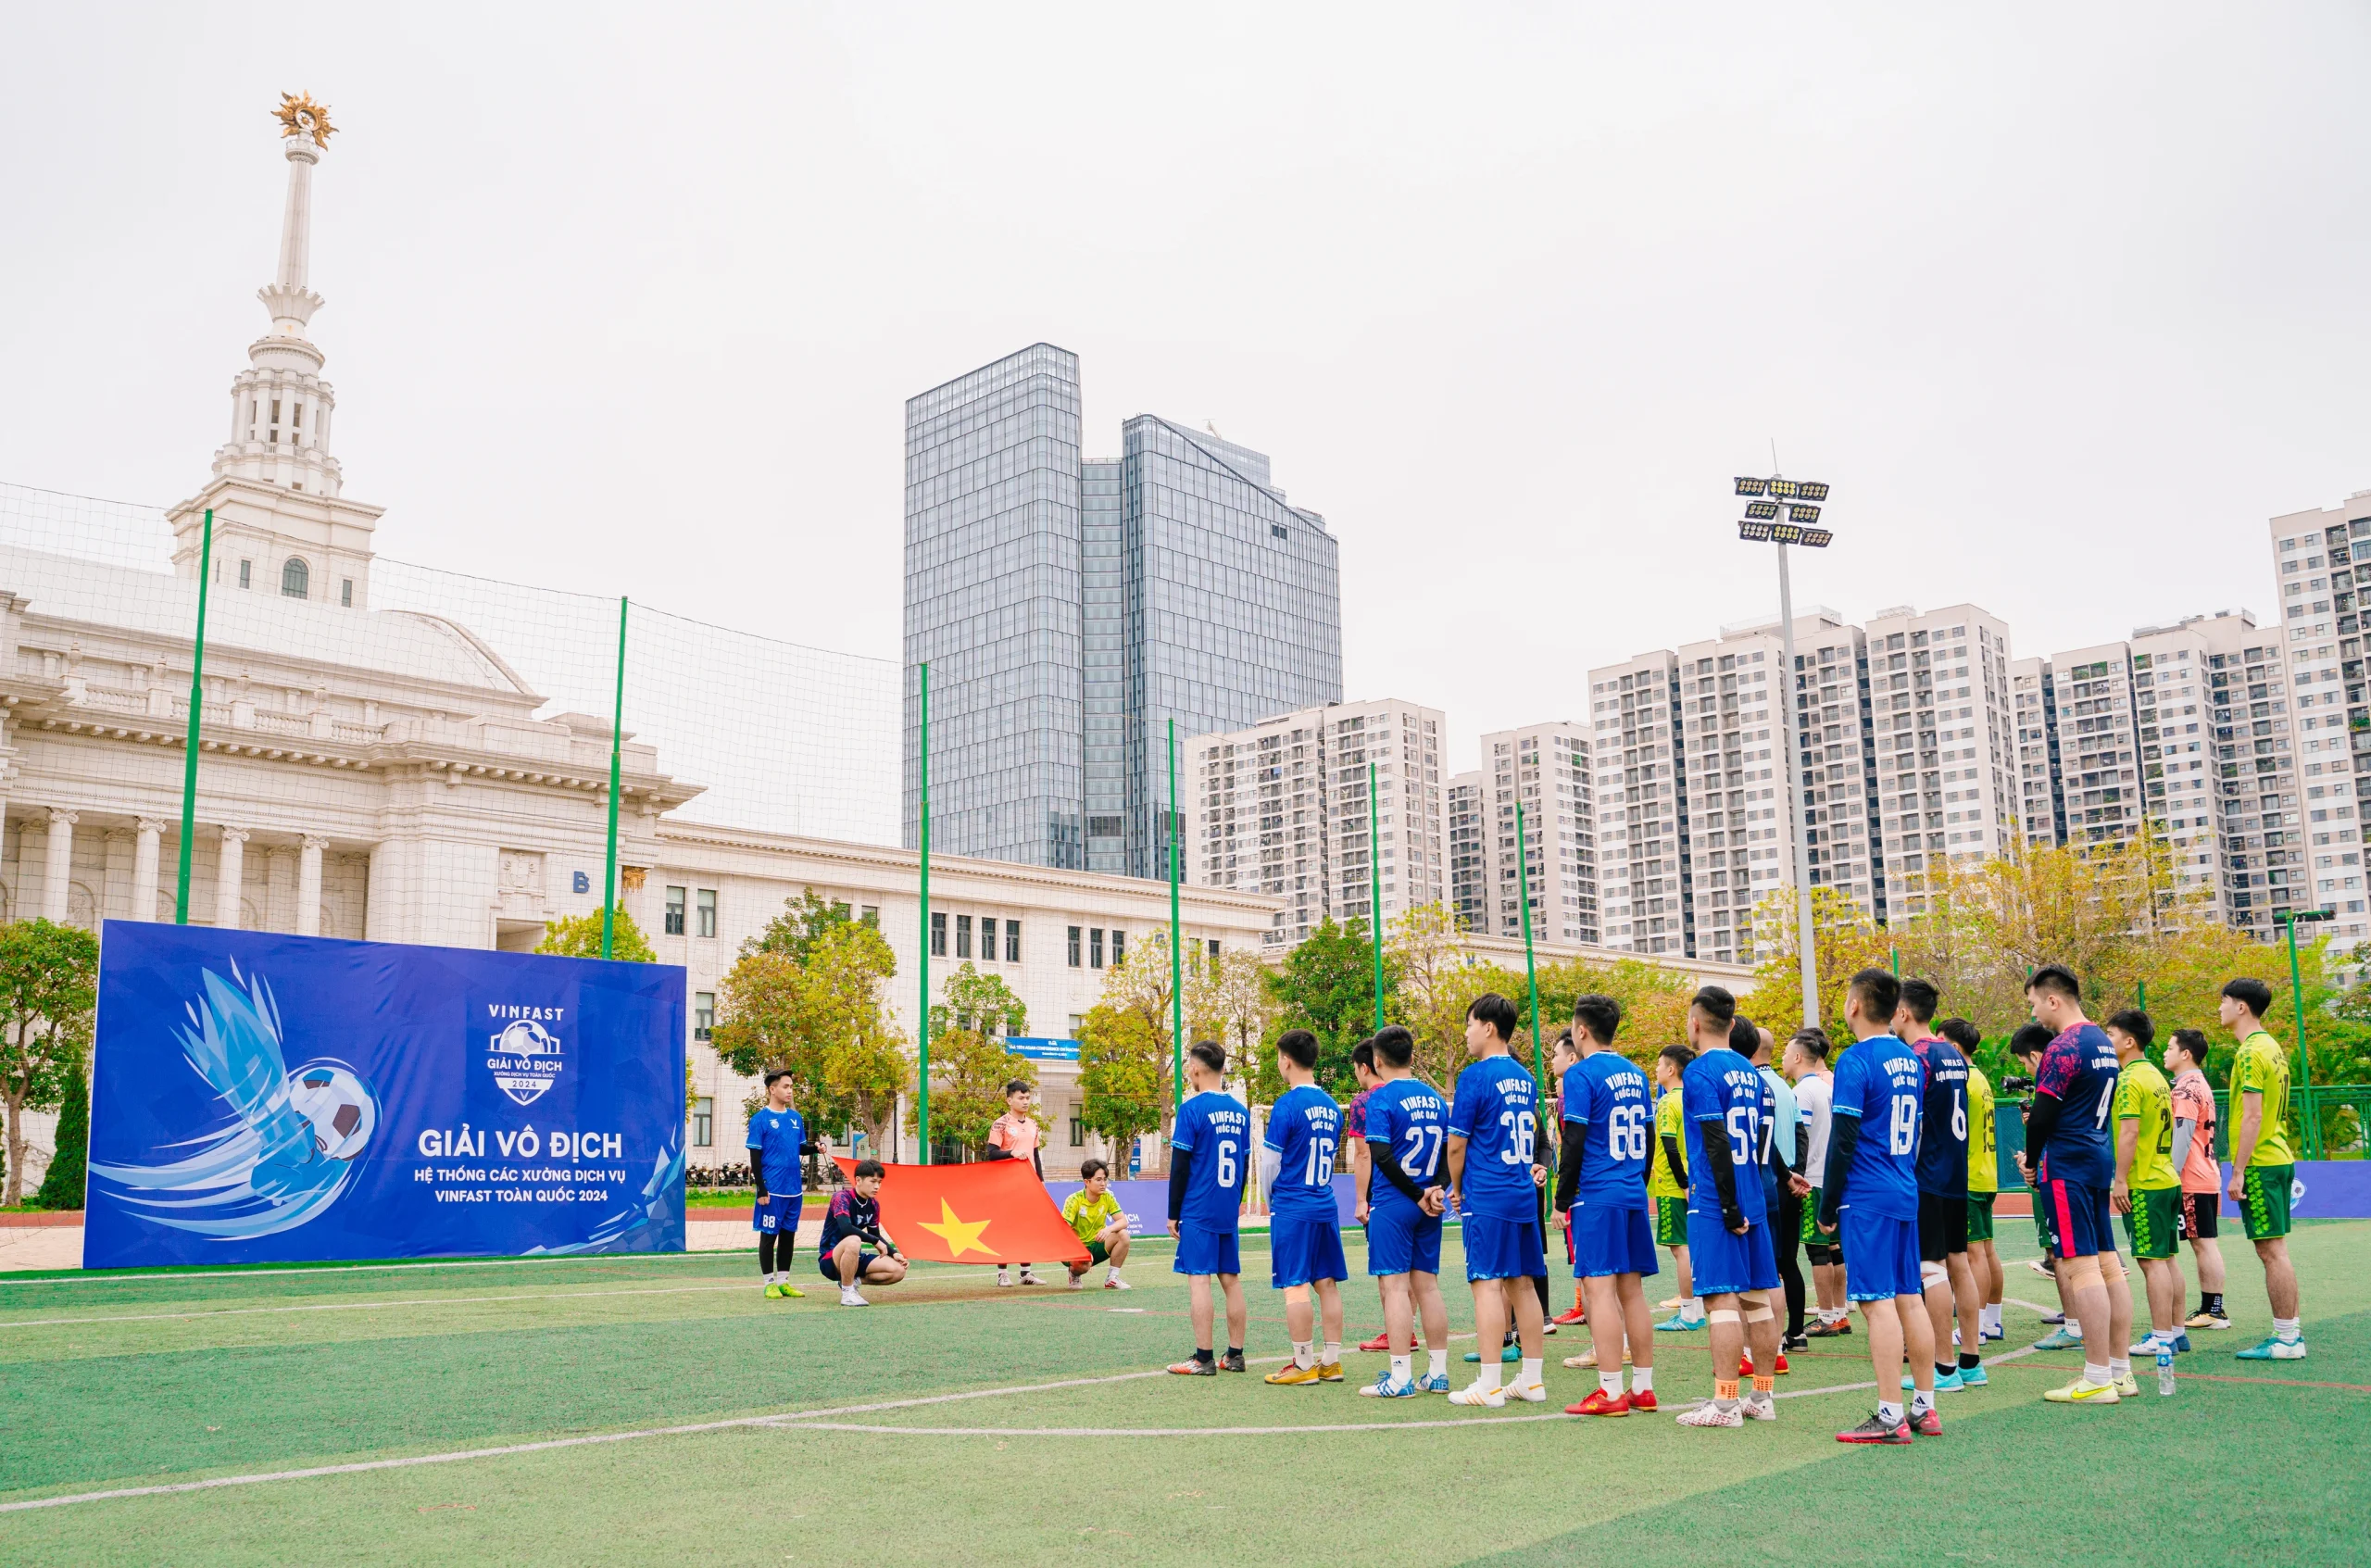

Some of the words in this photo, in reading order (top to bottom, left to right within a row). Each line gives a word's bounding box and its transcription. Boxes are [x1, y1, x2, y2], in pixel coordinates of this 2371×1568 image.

[573, 871, 590, 893] B
[488, 1004, 564, 1021] VINFAST
[487, 1057, 511, 1070] GIẢI
[515, 1058, 531, 1071] VÔ
[534, 1060, 562, 1073] ĐỊCH
[1883, 1057, 1918, 1075] VINFAST
[512, 1080, 536, 1088] 2024
[1496, 1078, 1532, 1095] VINFAST
[1605, 1072, 1643, 1091] VINFAST
[1906, 1075, 1917, 1088] OAI
[1517, 1096, 1529, 1105] OAI
[1630, 1088, 1642, 1099] OAI
[1399, 1096, 1441, 1111] VINFAST
[2096, 1077, 2114, 1130] 4
[1208, 1111, 1246, 1126] VINFAST
[1304, 1106, 1338, 1123] VINFAST
[1425, 1110, 1438, 1121] OAI
[1951, 1088, 1967, 1141] 6
[1231, 1125, 1242, 1135] OAI
[1323, 1121, 1335, 1132] OAI
[1609, 1104, 1646, 1160] 66
[1889, 1095, 1918, 1156] 19
[418, 1123, 485, 1157] GIẢI
[496, 1123, 540, 1158] VÔ
[549, 1132, 622, 1163] ĐỊCH
[1499, 1110, 1535, 1165] 36
[1726, 1107, 1759, 1165] 59
[1400, 1125, 1444, 1177] 27
[1217, 1140, 1237, 1188] 6
[1305, 1136, 1335, 1187] 16
[414, 1166, 433, 1184] HỆ
[437, 1165, 486, 1182] THỐNG
[489, 1166, 518, 1182] CÁC
[521, 1167, 571, 1182] XƯỞNG
[575, 1169, 605, 1184] DỊCH
[608, 1170, 626, 1185] VỤ
[434, 1189, 492, 1202] VINFAST
[496, 1187, 533, 1202] TOÀN
[535, 1186, 575, 1202] QUỐC
[579, 1190, 608, 1202] 2024
[762, 1214, 776, 1229] 88
[1124, 1213, 1140, 1223] ỊCH
[2177, 1214, 2187, 1231] 3
